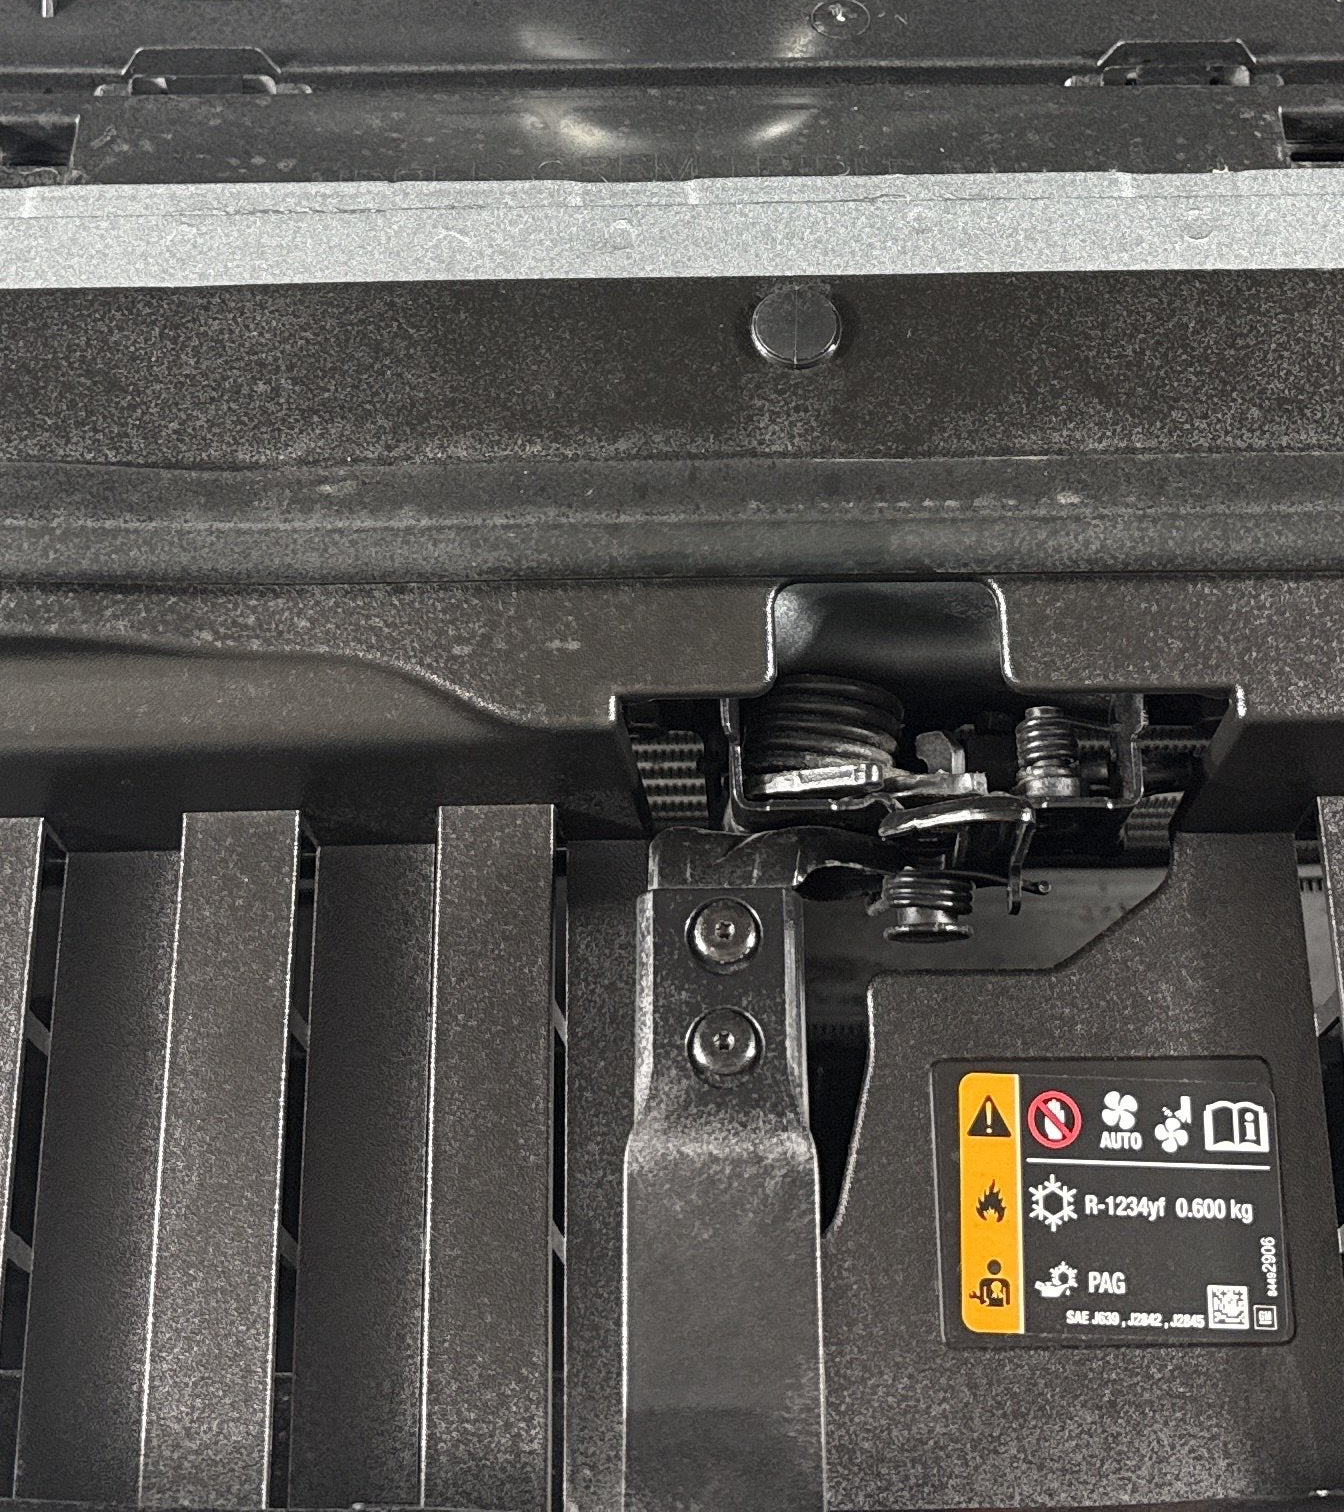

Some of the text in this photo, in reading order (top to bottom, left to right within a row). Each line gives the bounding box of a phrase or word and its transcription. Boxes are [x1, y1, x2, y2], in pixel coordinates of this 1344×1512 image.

[1099, 1131, 1143, 1151] AUTO
[1084, 1194, 1254, 1224] R-1234yf 0.600 kg
[1260, 1236, 1279, 1297] 84492906
[1088, 1271, 1126, 1294] PAG
[1066, 1310, 1090, 1325] SAE
[1170, 1313, 1206, 1328] J2845
